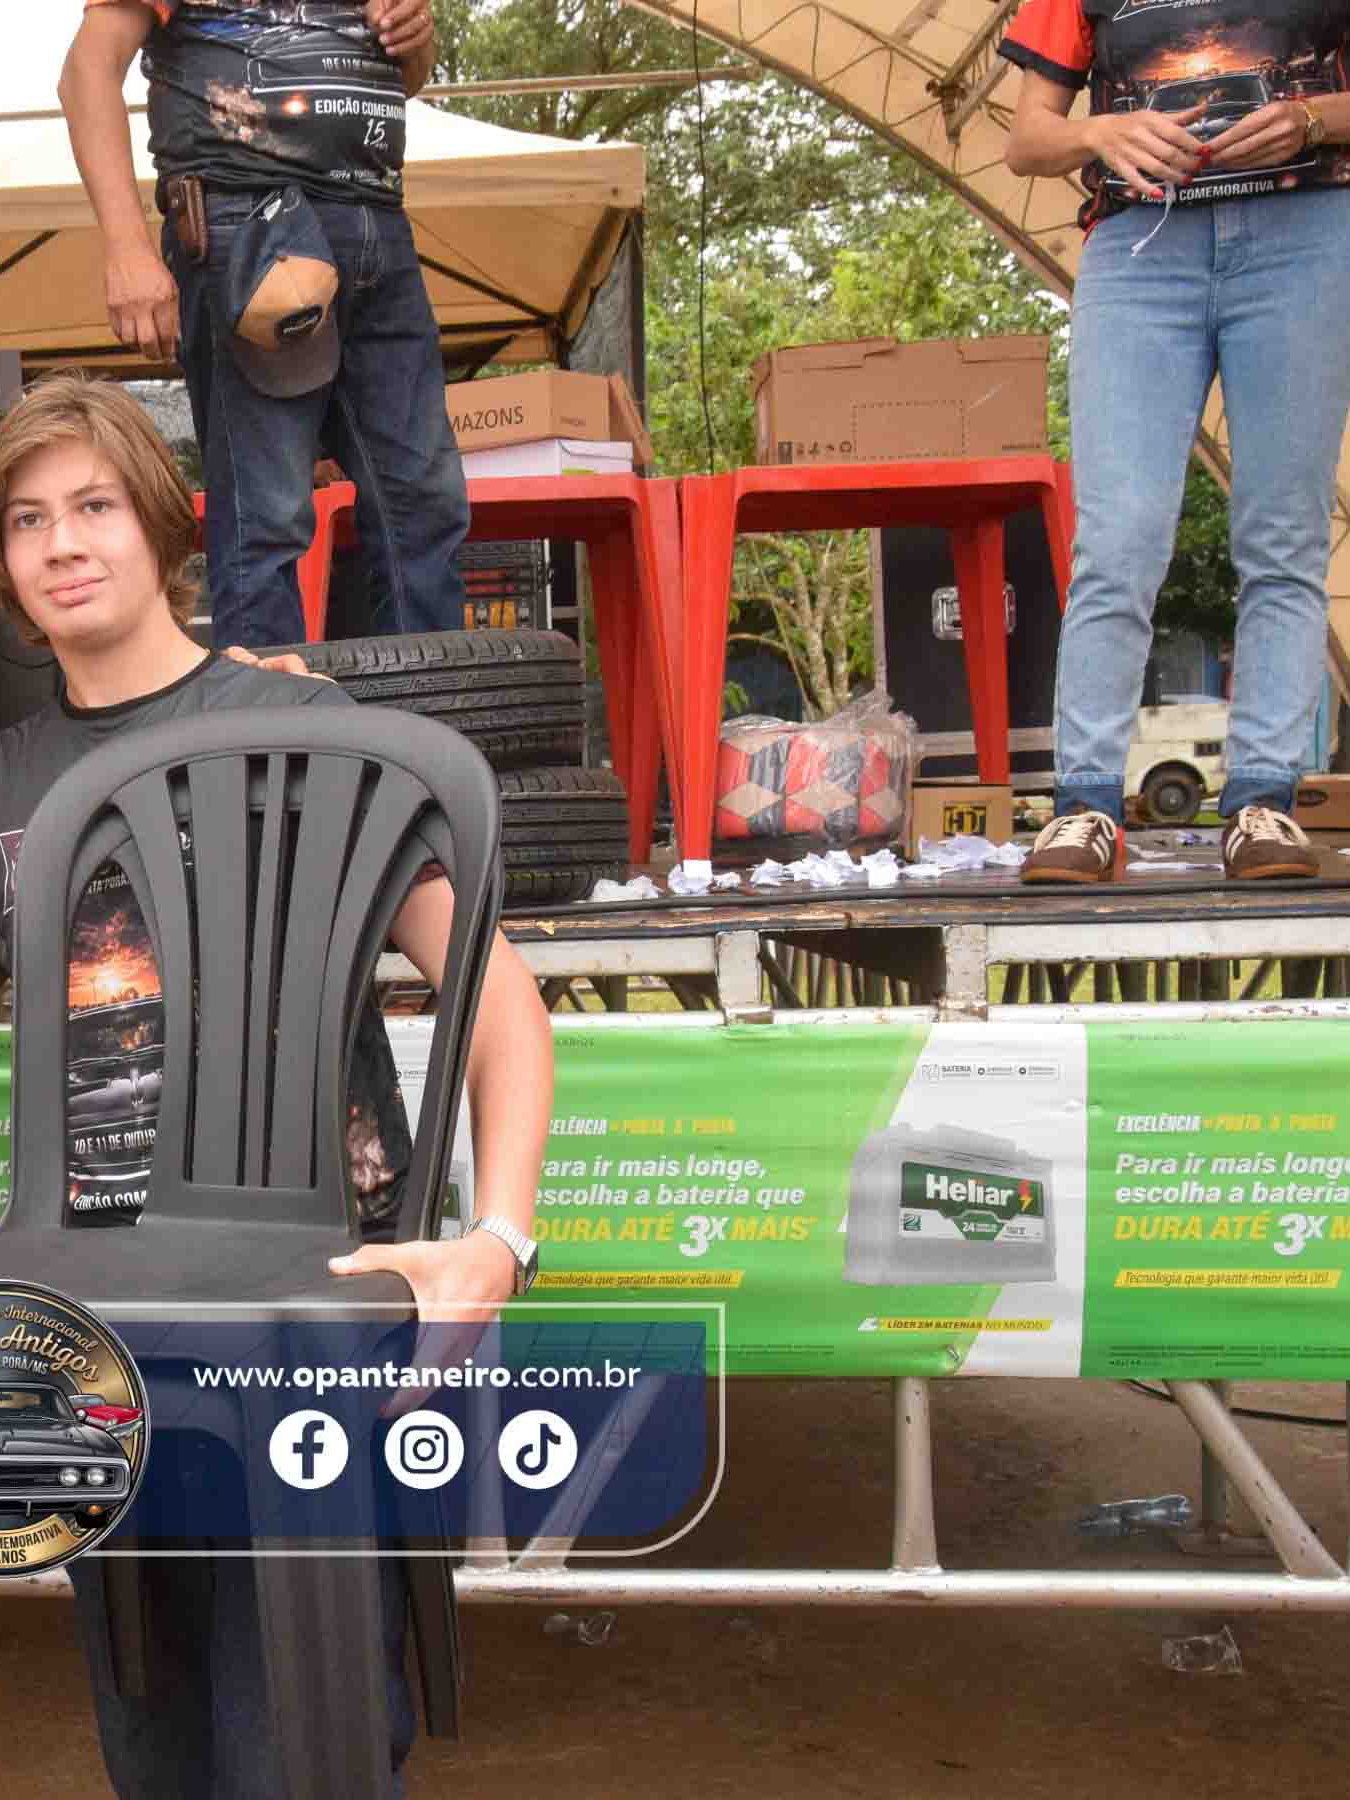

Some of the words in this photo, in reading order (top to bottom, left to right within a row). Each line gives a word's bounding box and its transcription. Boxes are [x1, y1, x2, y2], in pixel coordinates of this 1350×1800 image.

[315, 97, 359, 116] EDIÇÃO
[363, 118, 386, 145] 15
[1179, 180, 1274, 201] COMEMORATIVA
[540, 1158, 586, 1177] ara
[592, 1155, 613, 1177] ir
[617, 1155, 680, 1177] mais
[686, 1153, 766, 1181] longe,
[1116, 1153, 1178, 1174] Para
[1183, 1152, 1206, 1174] ir
[1210, 1152, 1276, 1174] mais
[634, 1188, 650, 1206] a
[656, 1183, 749, 1206] bateria
[755, 1187, 805, 1211] que
[925, 1174, 1013, 1206] Heliar
[1116, 1181, 1221, 1203] escolha
[1227, 1186, 1244, 1203] a
[1250, 1181, 1349, 1203] bateria
[533, 1215, 612, 1241] DURA
[618, 1211, 675, 1241] ATÉ
[1114, 1214, 1203, 1240] DURA
[1210, 1210, 1272, 1240] ATÉ
